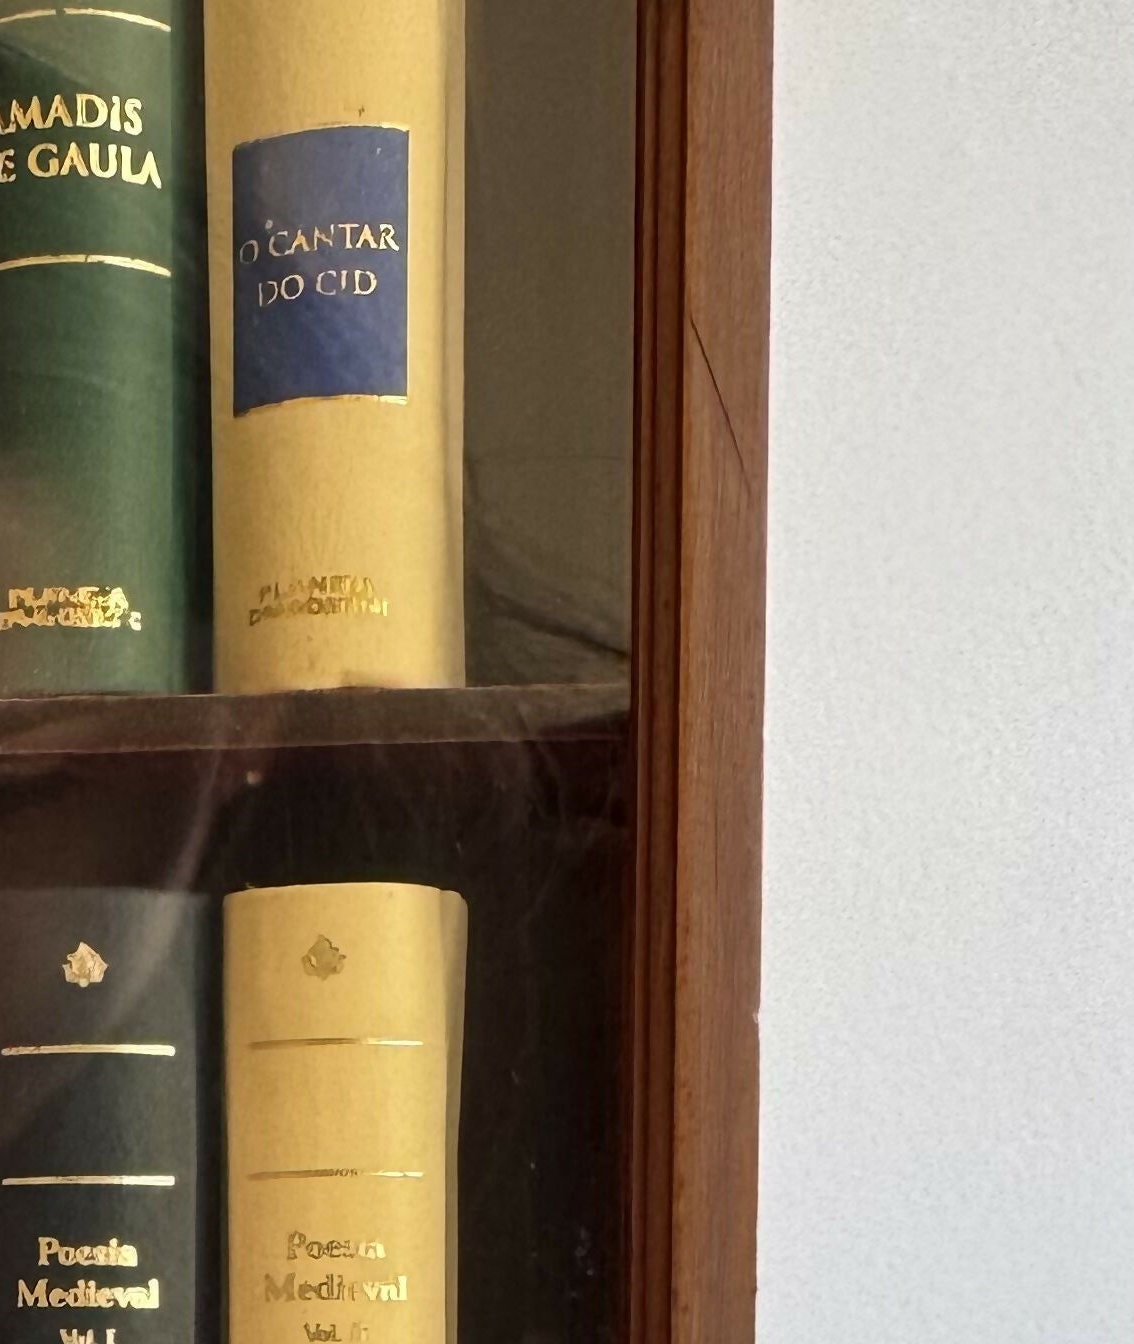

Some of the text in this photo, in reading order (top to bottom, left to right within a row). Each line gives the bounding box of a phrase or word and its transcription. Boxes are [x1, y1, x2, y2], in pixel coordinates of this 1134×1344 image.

[27, 142, 162, 190] GAULA
[239, 222, 400, 265] O CANTAR
[258, 268, 378, 308] DO CID
[37, 1236, 139, 1268] Poesia
[17, 1277, 160, 1310] Medieval
